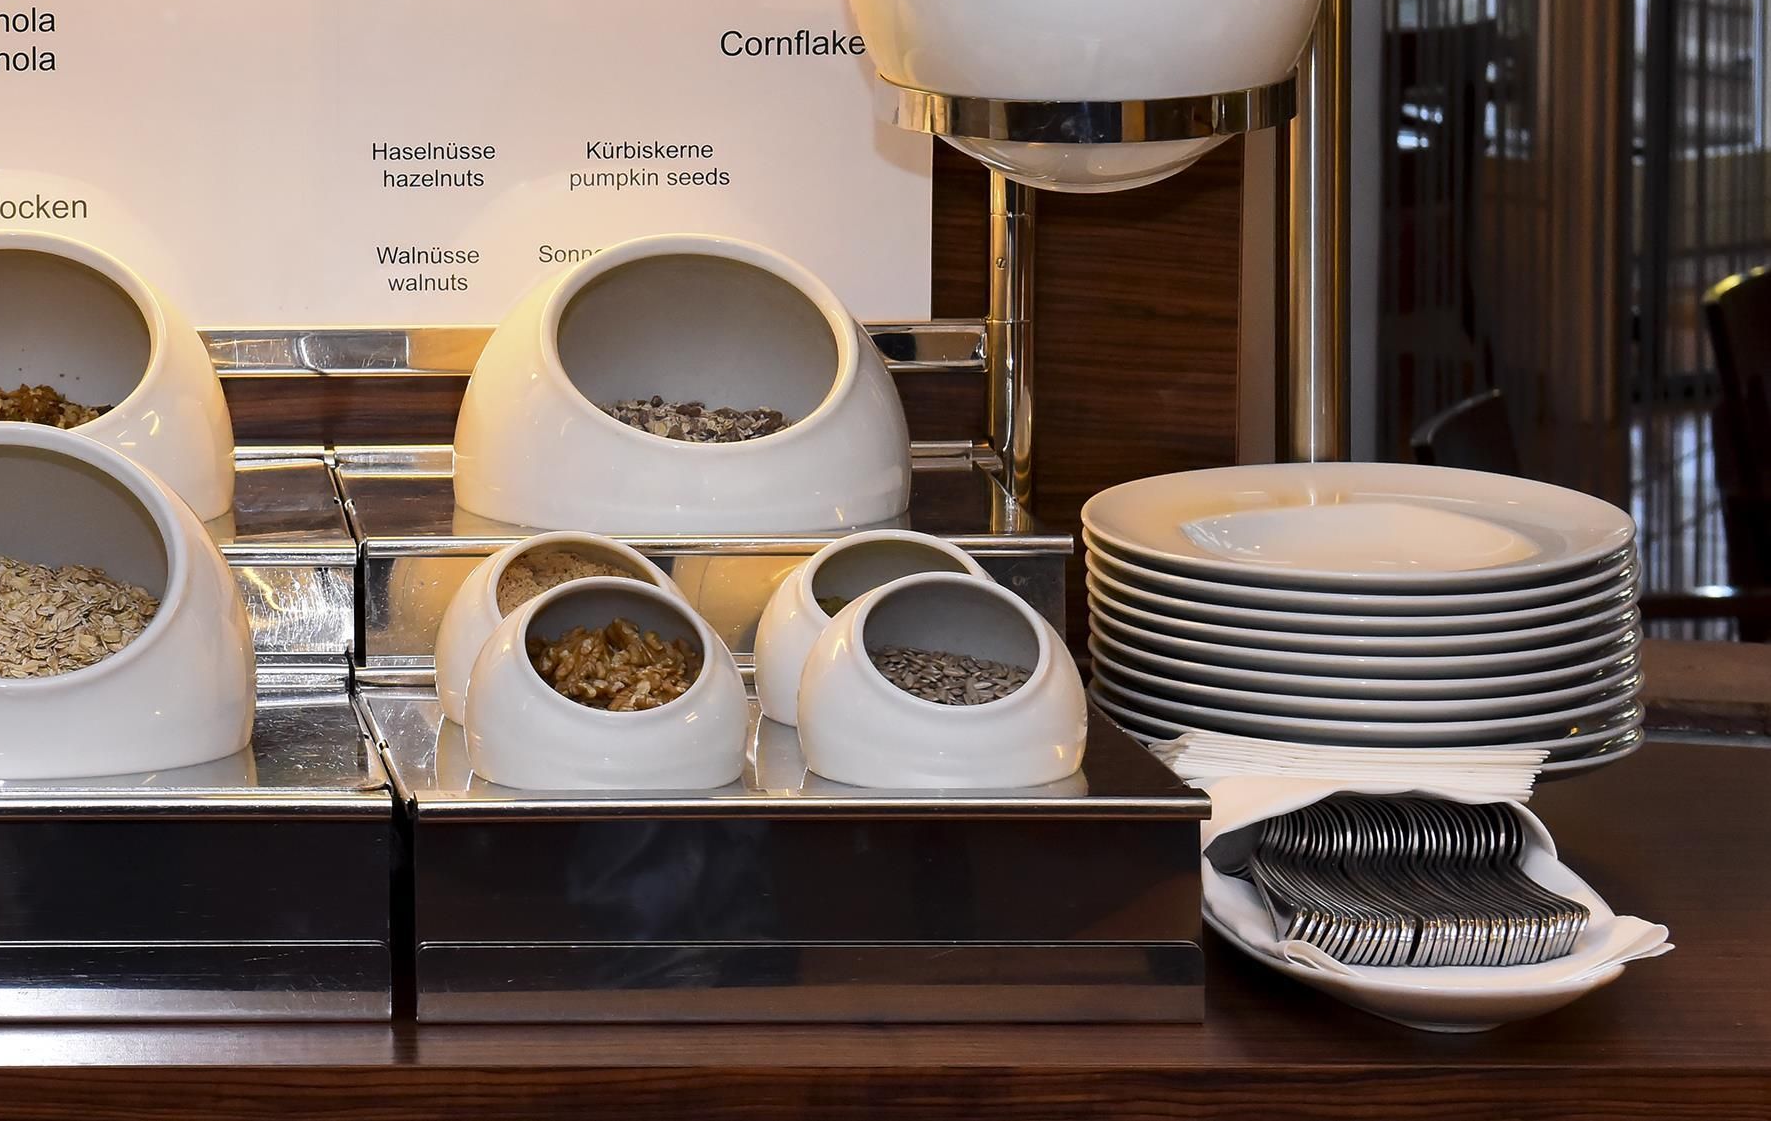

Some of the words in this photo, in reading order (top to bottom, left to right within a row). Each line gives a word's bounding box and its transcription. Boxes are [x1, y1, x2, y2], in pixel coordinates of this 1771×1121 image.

[372, 141, 496, 161] Haselnüsse
[586, 140, 714, 160] Kürbiskerne
[383, 168, 485, 188] hazelnuts
[570, 168, 659, 191] pumpkin
[666, 167, 731, 186] seeds
[376, 246, 480, 265] Walnüsse
[387, 273, 469, 291] walnuts
